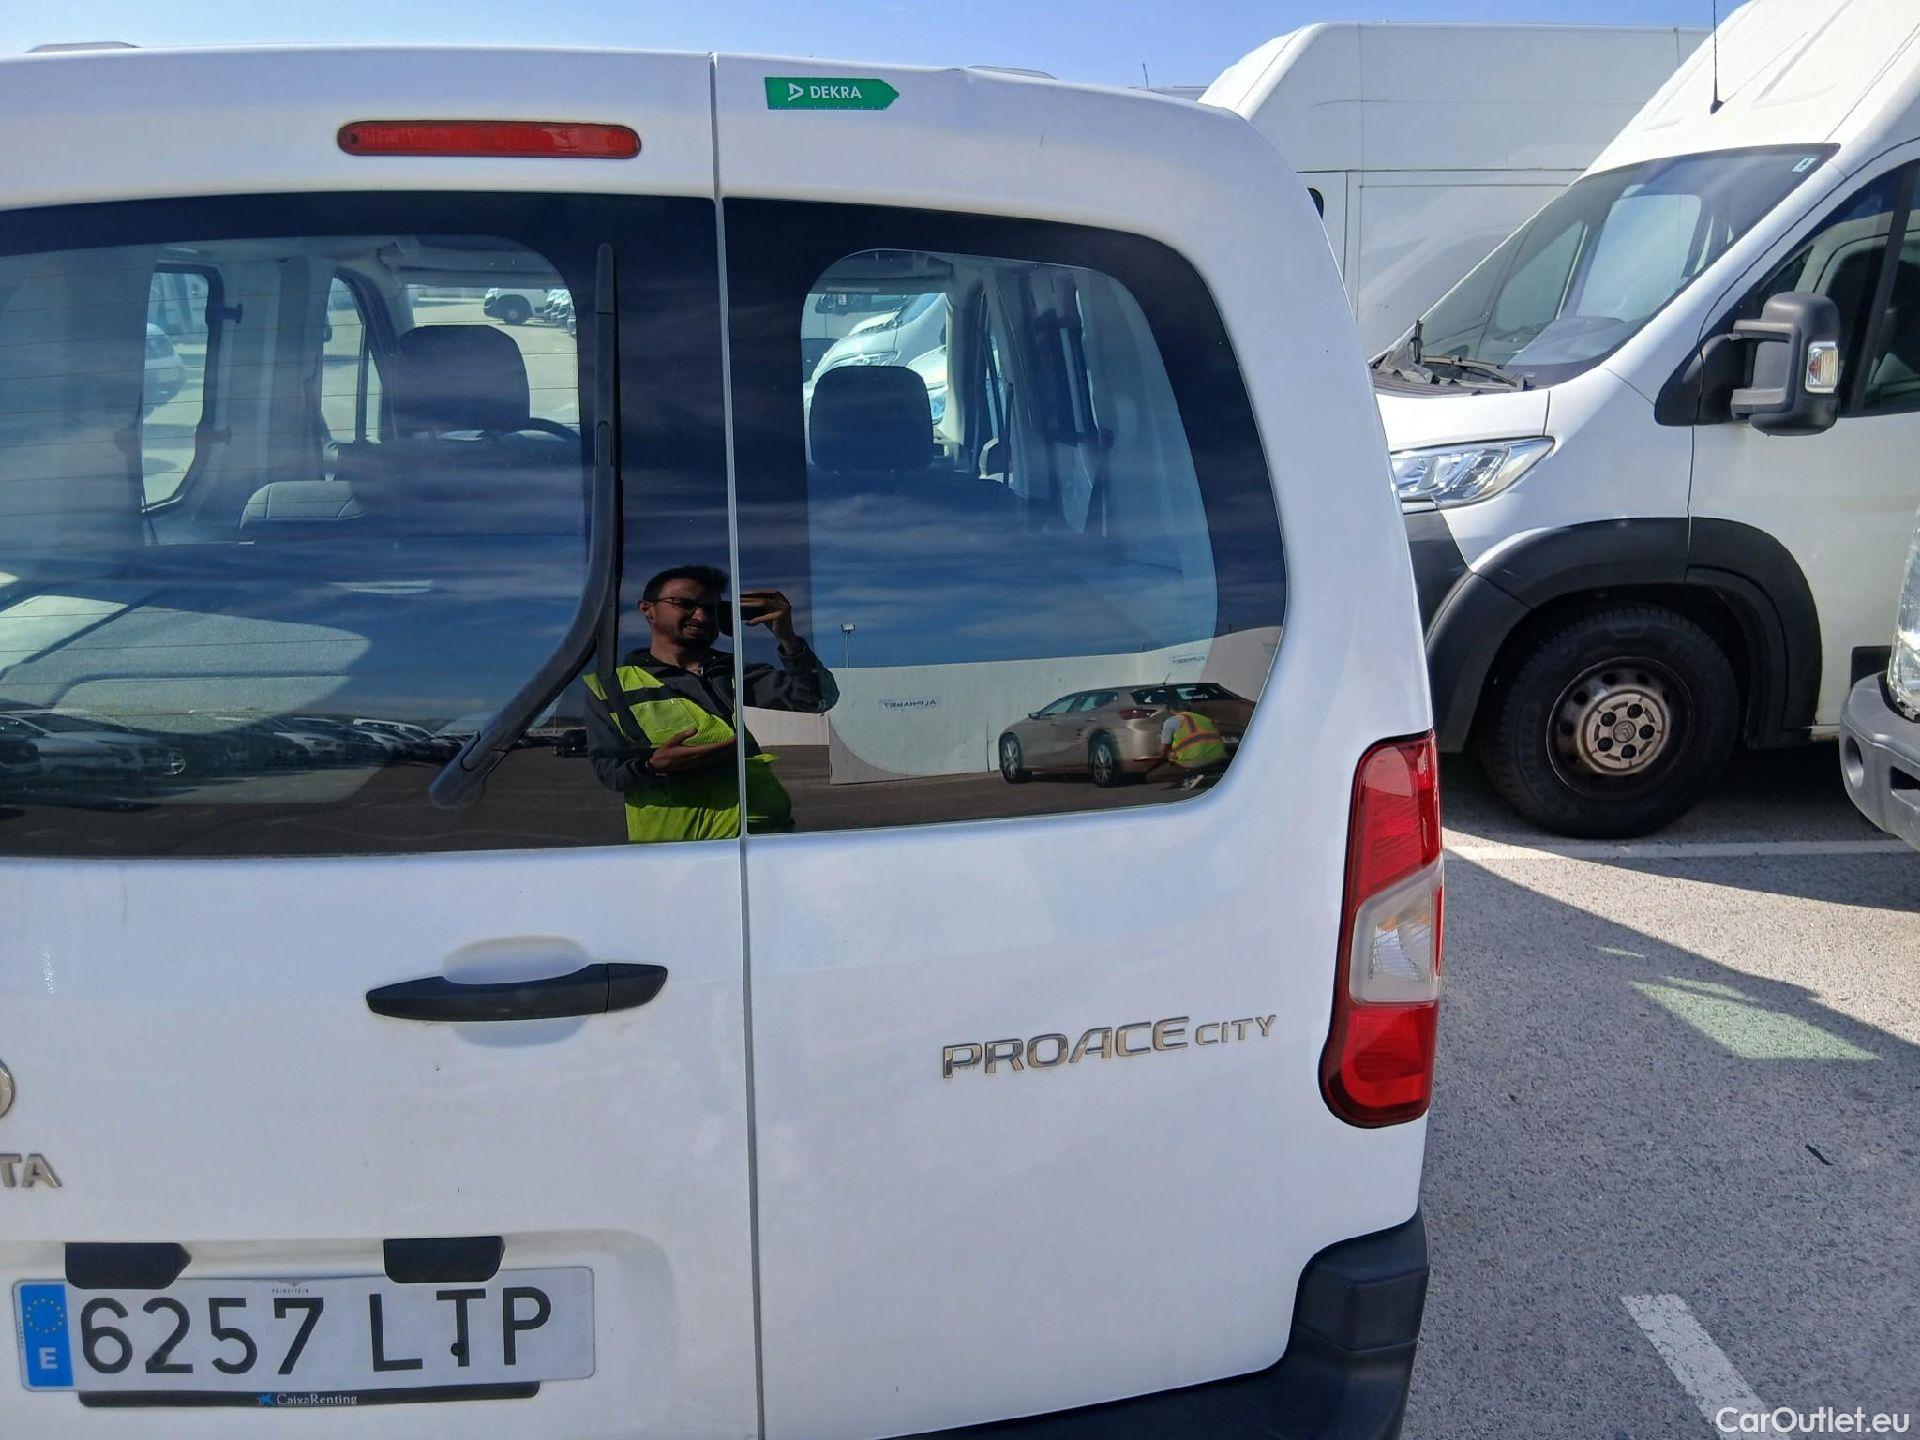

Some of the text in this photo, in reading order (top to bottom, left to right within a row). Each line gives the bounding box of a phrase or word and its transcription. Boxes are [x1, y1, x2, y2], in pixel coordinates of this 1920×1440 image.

[809, 85, 862, 99] DEKRA
[942, 1014, 1277, 1079] PROACE CITY
[0, 1153, 62, 1188] TA
[80, 1286, 552, 1375] 6257 LTP
[38, 1346, 58, 1370] E
[276, 1393, 359, 1406] CaixaRenting
